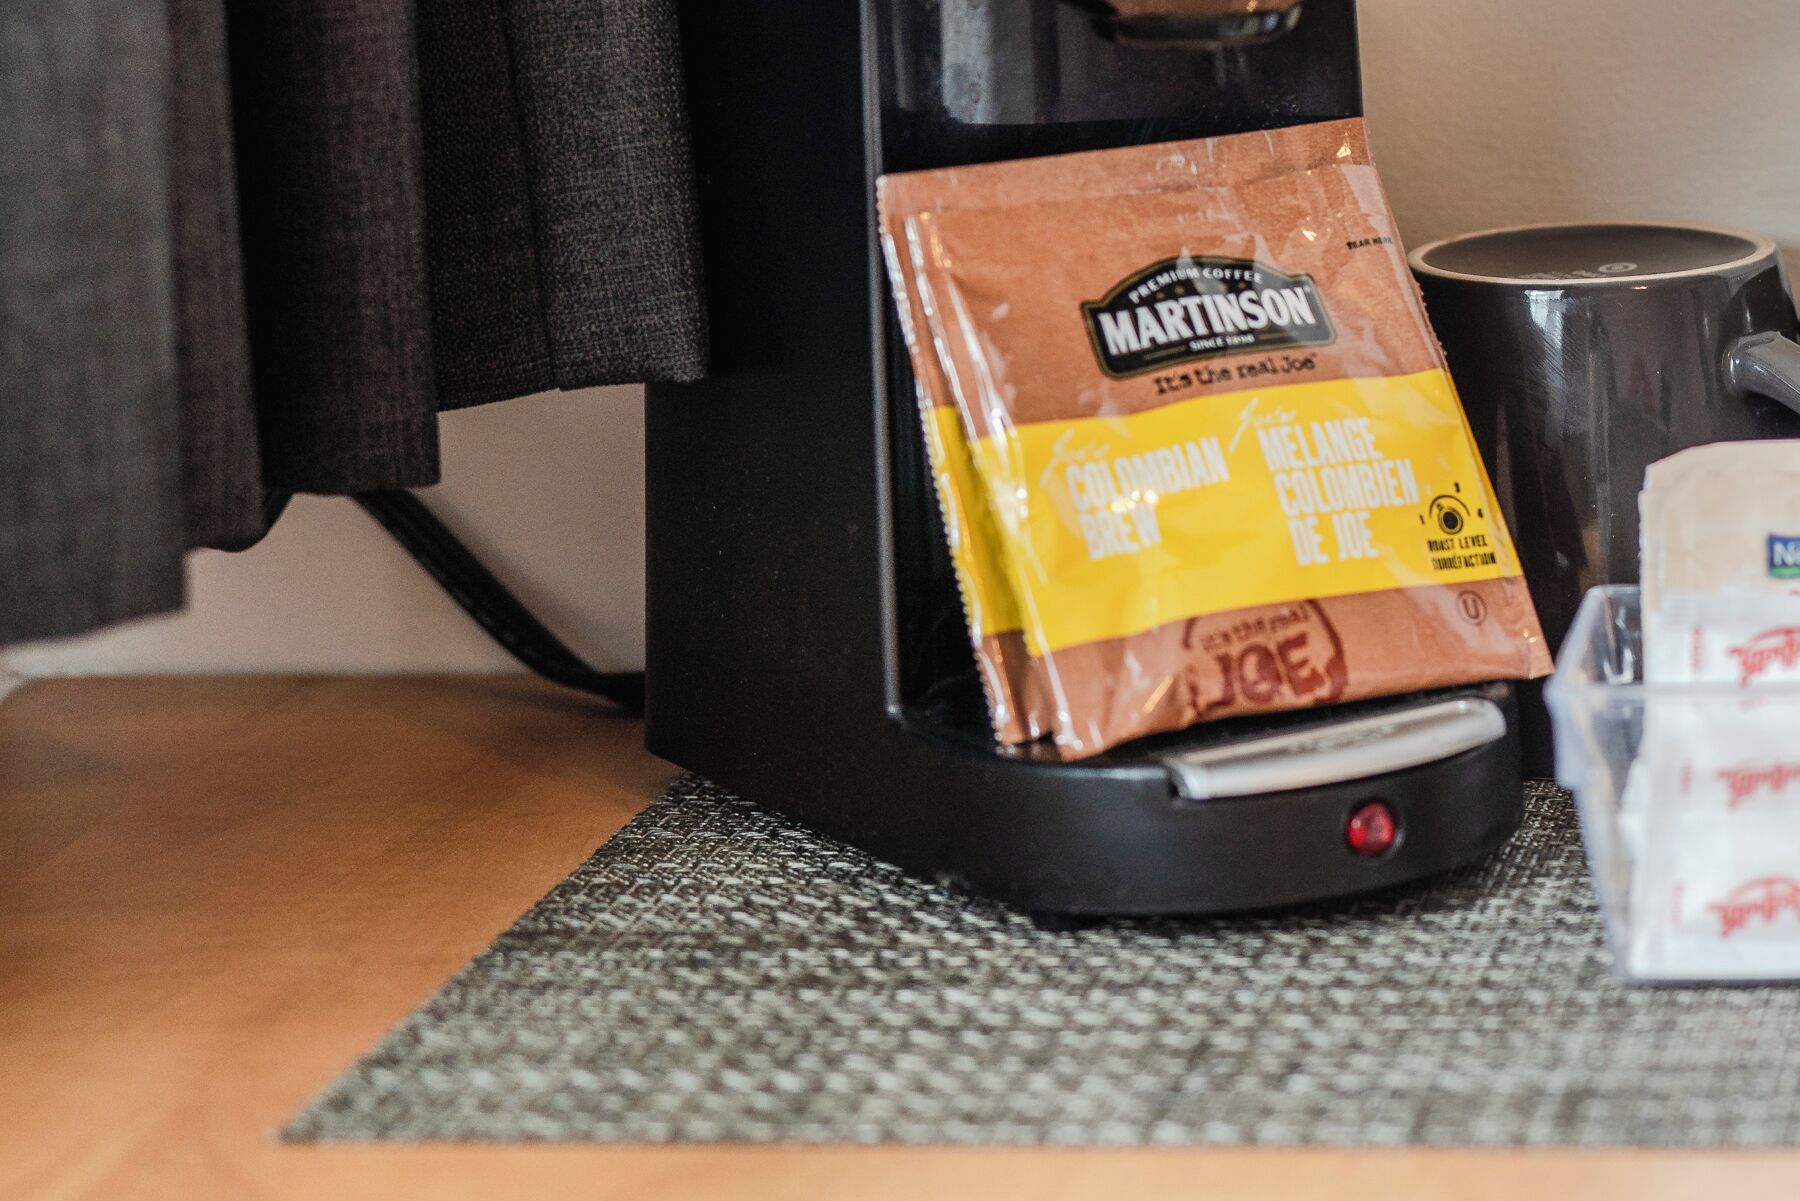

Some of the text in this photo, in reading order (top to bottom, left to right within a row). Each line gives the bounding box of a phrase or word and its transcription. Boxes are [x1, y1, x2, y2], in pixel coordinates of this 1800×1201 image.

[1128, 267, 1263, 304] PREMIUM COFFEE
[1098, 286, 1316, 356] MARTINSON
[1189, 338, 1224, 351] SINCE
[1154, 374, 1192, 395] It's
[1194, 366, 1233, 386] the
[1237, 357, 1280, 378] real
[1066, 435, 1231, 511] COLOMBIAN
[1274, 458, 1420, 517] COLOMBIEN
[1080, 502, 1161, 561] BREW
[1288, 511, 1381, 566] DE JOE
[1459, 534, 1487, 548] LEVEL
[1205, 632, 1325, 711] JOE
